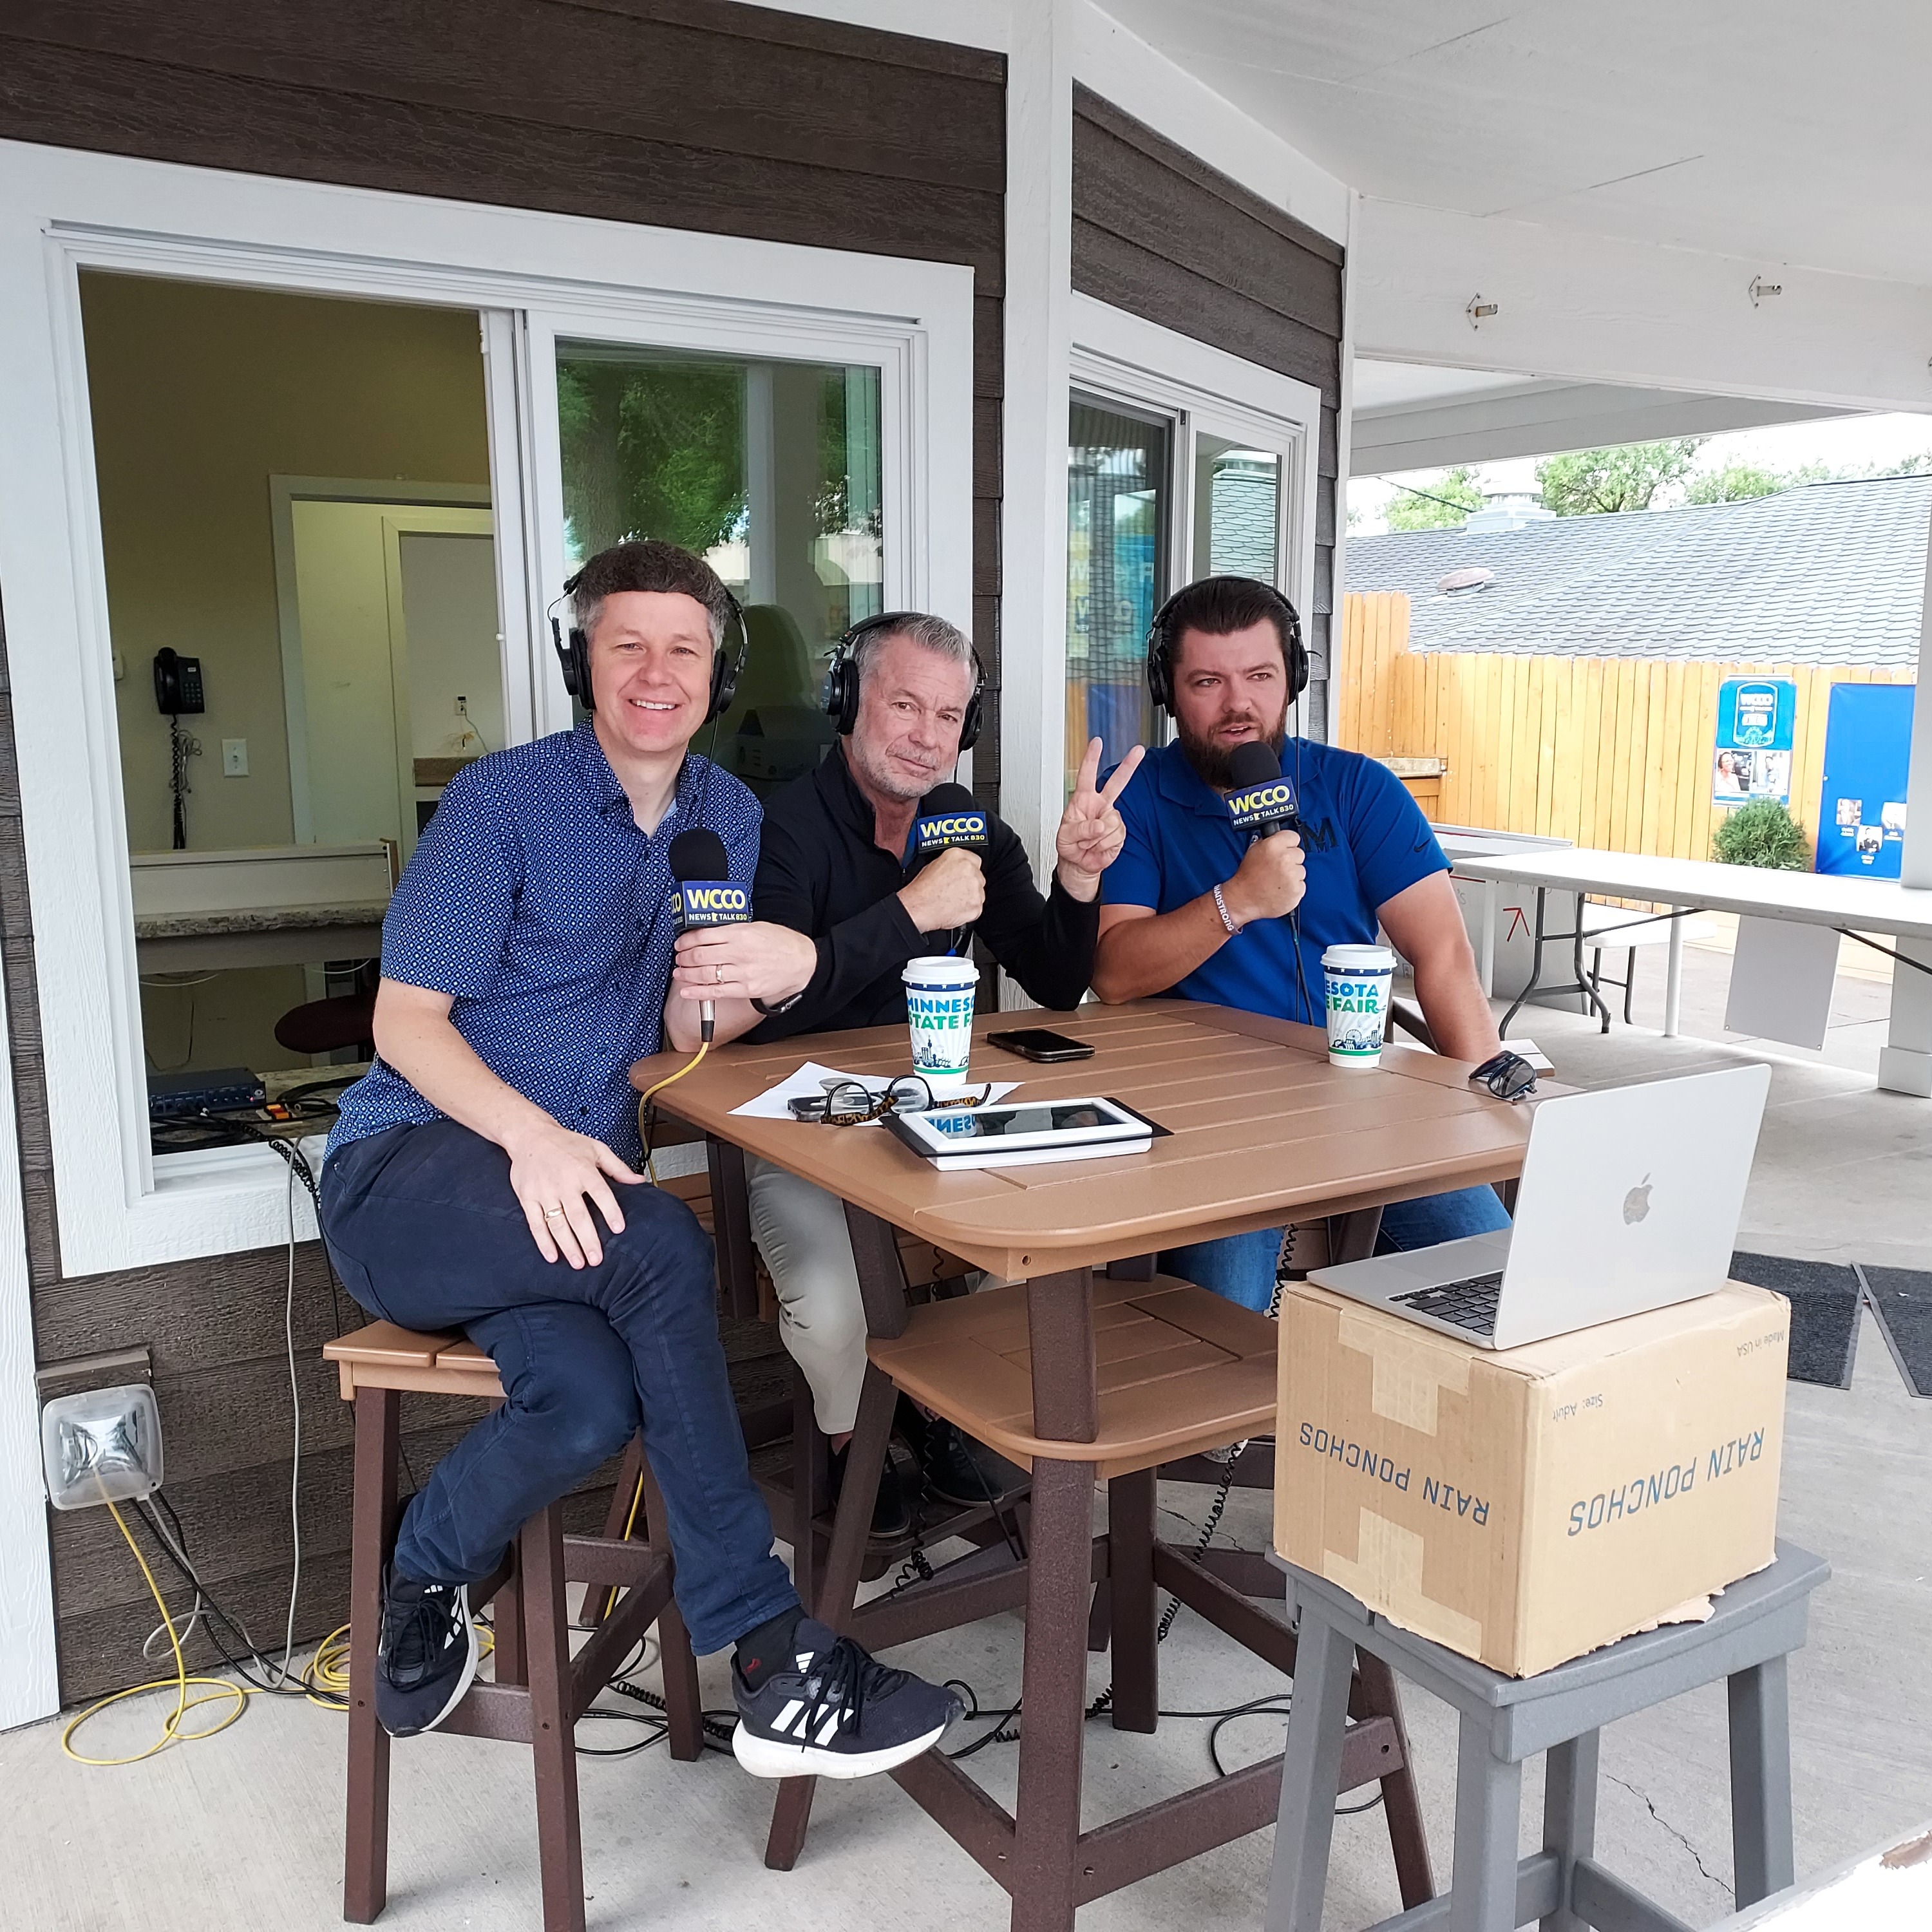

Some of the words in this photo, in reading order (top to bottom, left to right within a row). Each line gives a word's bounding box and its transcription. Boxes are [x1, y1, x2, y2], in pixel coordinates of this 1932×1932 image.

[1228, 785, 1290, 815] WCCO
[1233, 815, 1254, 826] NEWS
[1260, 807, 1279, 817] TALK
[1280, 804, 1294, 813] 830
[920, 817, 984, 837] WCCO
[922, 838, 943, 847] NEWS
[687, 889, 746, 909] WCCO
[1325, 979, 1379, 998] ESOTA
[1332, 998, 1378, 1014] FAIR
[909, 1010, 960, 1030] STATE
[963, 1013, 973, 1027] F
[1755, 1338, 1762, 1350] in
[1763, 1330, 1785, 1347] Made
[1737, 1341, 1754, 1357] USA
[1582, 1394, 1604, 1409] Size:
[1553, 1403, 1577, 1423] Adult
[1299, 1422, 1411, 1492] PONCHOS
[1707, 1426, 1765, 1482] RAIN
[1423, 1477, 1490, 1526] RAIN
[1567, 1456, 1698, 1537] PONCHOS
